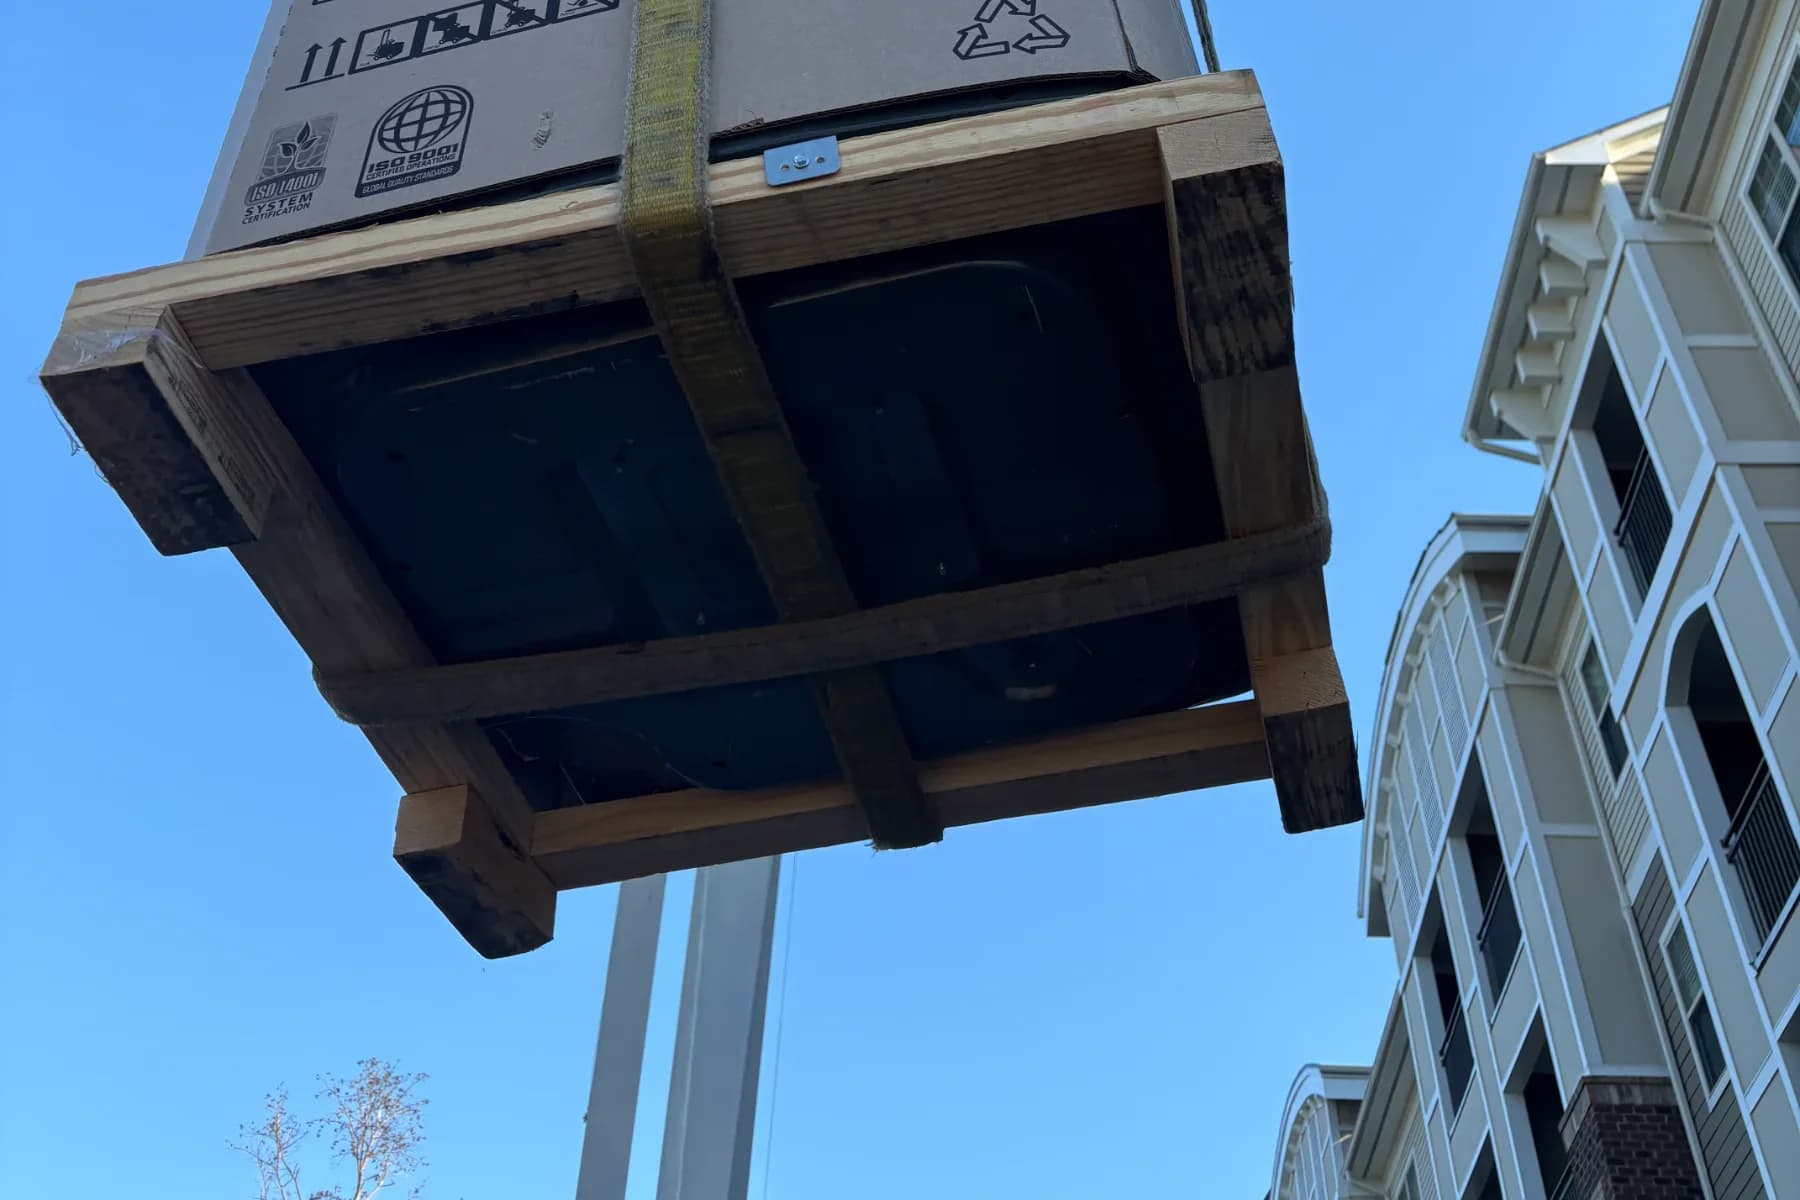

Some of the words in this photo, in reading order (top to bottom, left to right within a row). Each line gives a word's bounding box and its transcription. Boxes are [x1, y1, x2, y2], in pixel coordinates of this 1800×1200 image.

[366, 165, 406, 180] CERTIFIED
[406, 153, 457, 171] OPERATIONS
[368, 155, 406, 173] ISO
[407, 143, 459, 164] 9001
[251, 182, 277, 201] ISO
[279, 172, 319, 194] 14001
[242, 202, 311, 225] CERTIFICATION
[244, 191, 314, 217] SYSTEM
